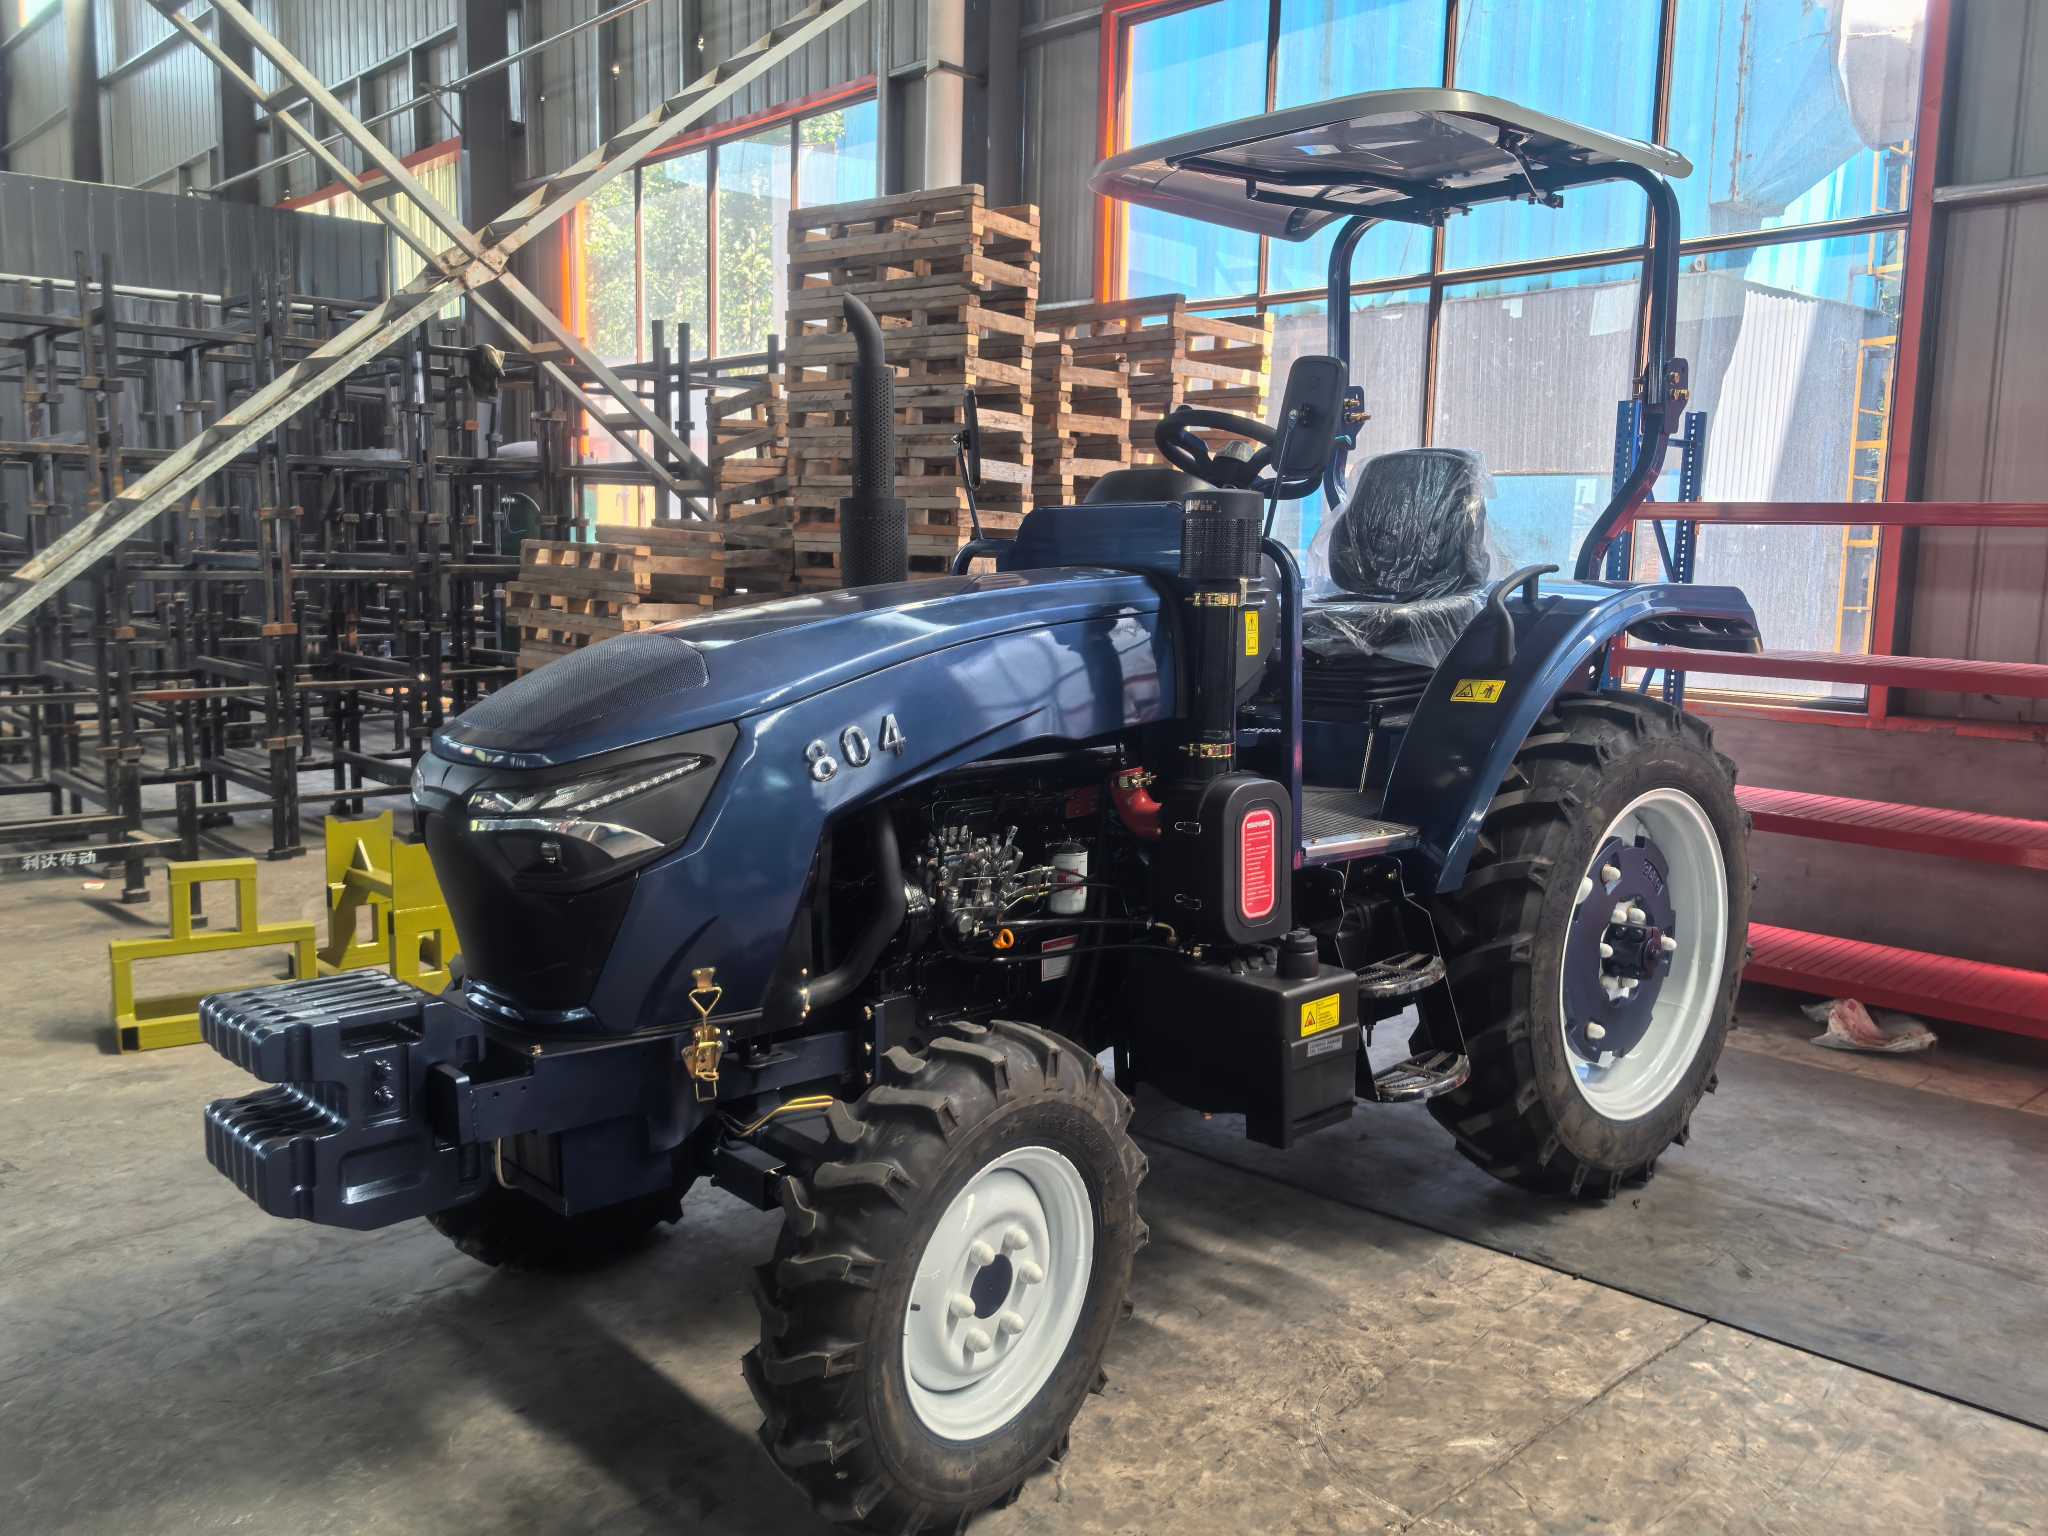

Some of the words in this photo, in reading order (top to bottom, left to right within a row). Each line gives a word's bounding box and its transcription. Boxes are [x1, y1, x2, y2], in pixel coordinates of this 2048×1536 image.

[805, 713, 906, 782] 804
[21, 850, 97, 871] 利达传动
